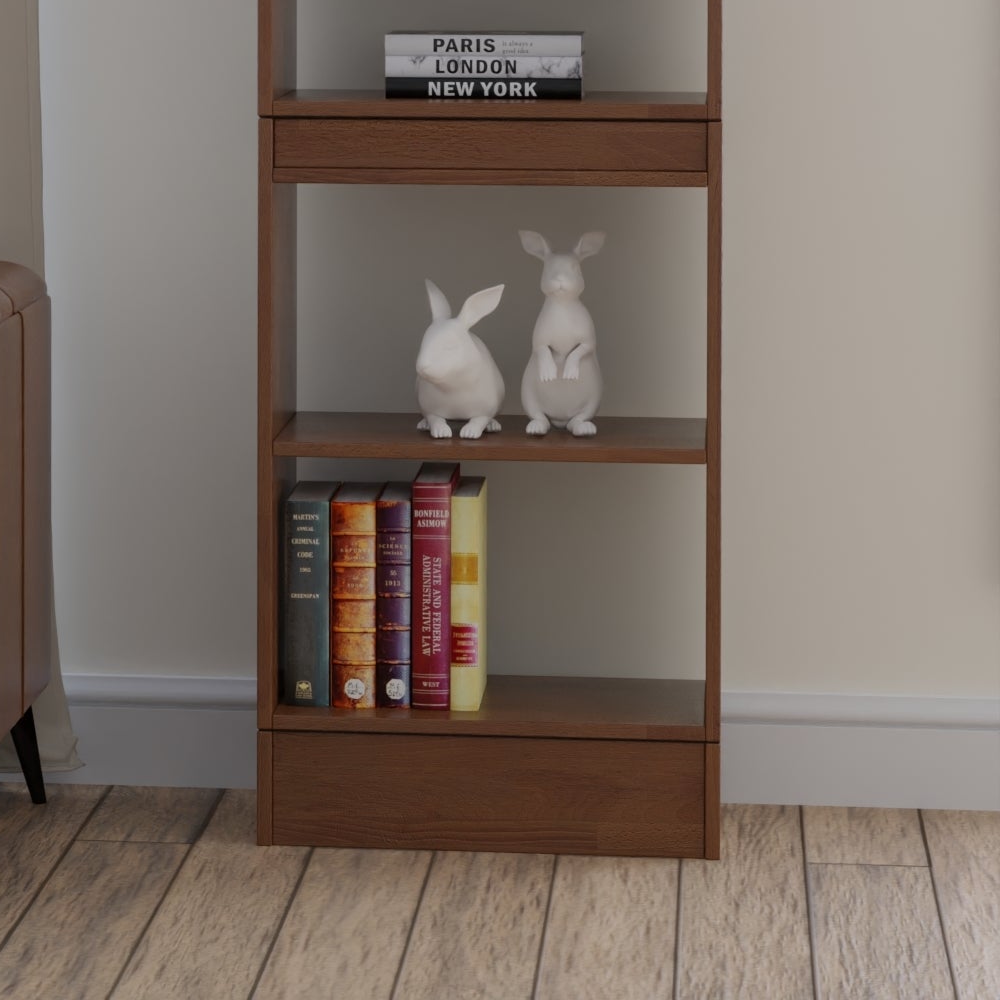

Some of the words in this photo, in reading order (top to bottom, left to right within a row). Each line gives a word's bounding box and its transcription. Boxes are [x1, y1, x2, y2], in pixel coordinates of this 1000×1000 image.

[433, 38, 496, 53] PARIS
[435, 59, 517, 74] LONDON
[428, 81, 475, 97] NEW
[480, 81, 538, 97] YORK
[292, 513, 319, 521] MARTIN'S
[414, 509, 449, 518] BONFIELD
[417, 519, 447, 528] ASIMOW
[432, 557, 442, 586] STATE
[422, 555, 432, 632] ADMINISTRATIVE
[432, 589, 442, 608] AND
[432, 612, 442, 655] FEDERAL
[421, 635, 431, 657] LAW
